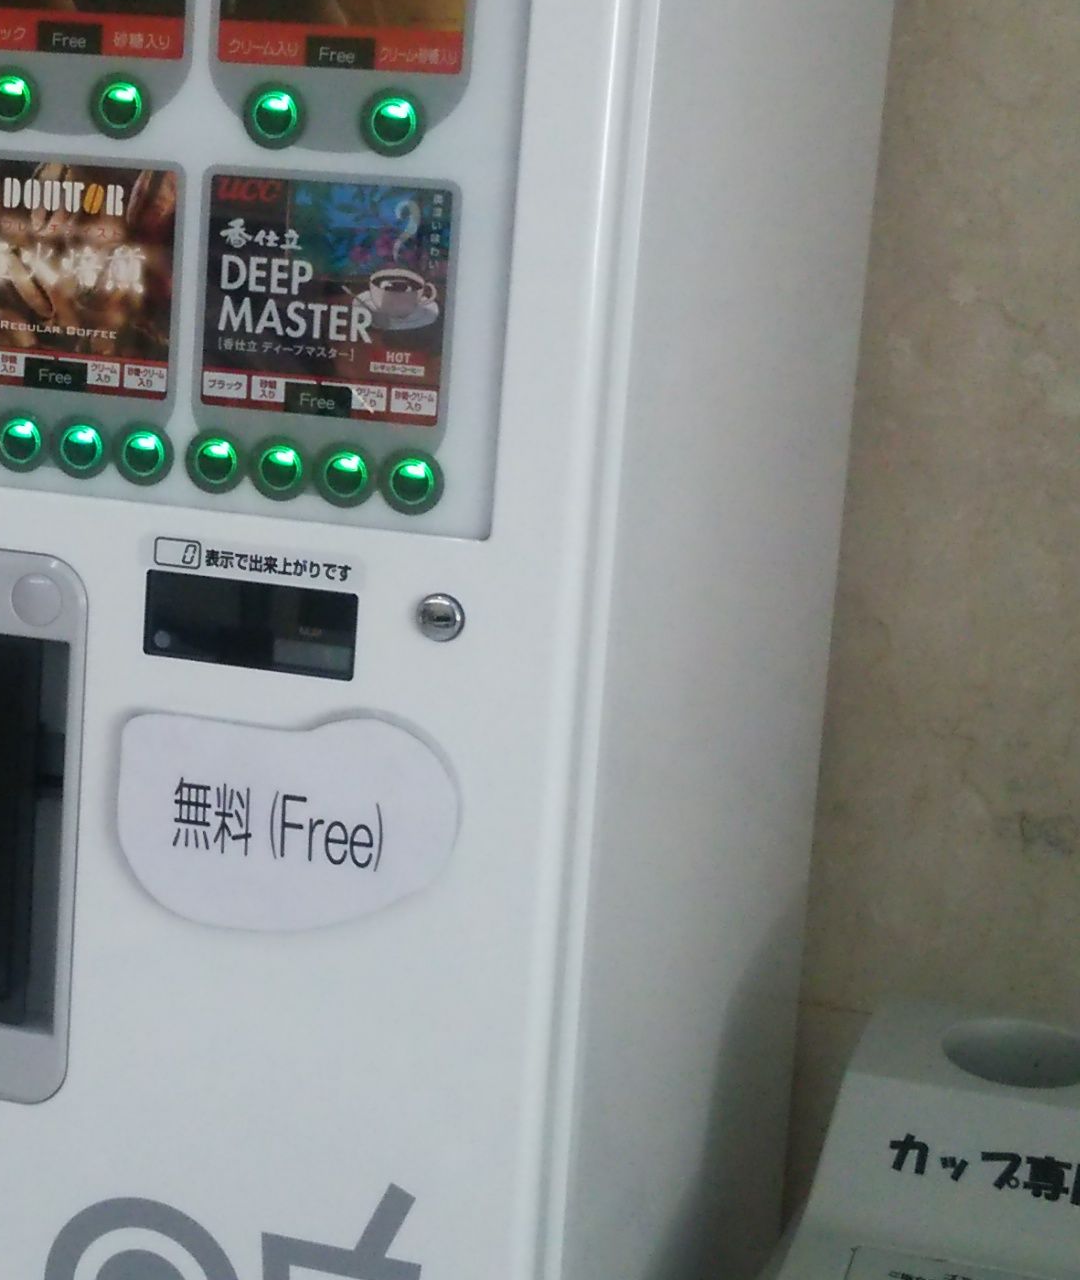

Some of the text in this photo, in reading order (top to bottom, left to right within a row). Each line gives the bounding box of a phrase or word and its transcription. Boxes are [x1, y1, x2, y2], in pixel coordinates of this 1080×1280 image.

[52, 33, 86, 49] Free
[112, 32, 171, 50] 砂糖入り
[229, 40, 299, 56] クリーム入り
[319, 47, 356, 63] Free
[3, 177, 124, 216] DOUTOR
[217, 179, 281, 202] UCC
[220, 218, 303, 250] 香仕立
[220, 254, 314, 295] DEEP
[218, 296, 373, 344] MASTER
[0, 320, 117, 340] REGULAR COFFEE
[386, 352, 411, 363] HOT
[1, 363, 16, 374] 入り
[91, 363, 118, 374] クリーム
[38, 370, 72, 385] Free
[96, 373, 111, 384] 入り
[138, 377, 152, 388] 入り
[208, 379, 242, 391] ブラック
[260, 389, 275, 399] 入り
[300, 393, 336, 410] Free
[406, 401, 422, 412] 入り
[205, 549, 352, 582] 表示で出来上がりです
[173, 777, 383, 872] 無料 (Free)
